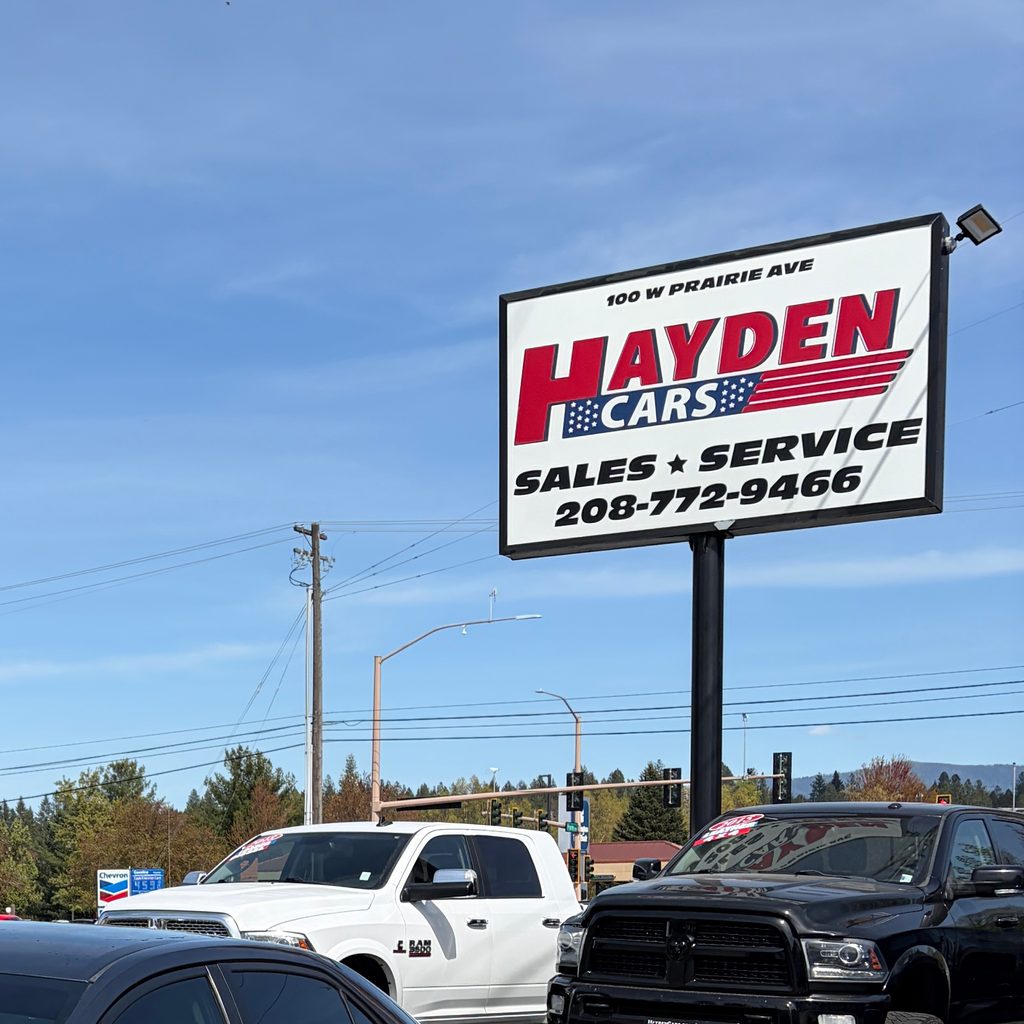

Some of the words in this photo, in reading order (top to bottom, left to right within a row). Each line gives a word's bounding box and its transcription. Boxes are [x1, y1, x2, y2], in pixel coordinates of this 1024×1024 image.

[606, 292, 641, 307] 100
[645, 285, 665, 301] W
[668, 267, 763, 296] PRAIRIE
[767, 258, 815, 278] AVE
[514, 288, 901, 446] HAYDEN
[600, 382, 722, 430] CARS
[514, 454, 658, 496] SALES
[698, 418, 923, 473] SERVICE
[554, 465, 863, 528] 208-772-9466
